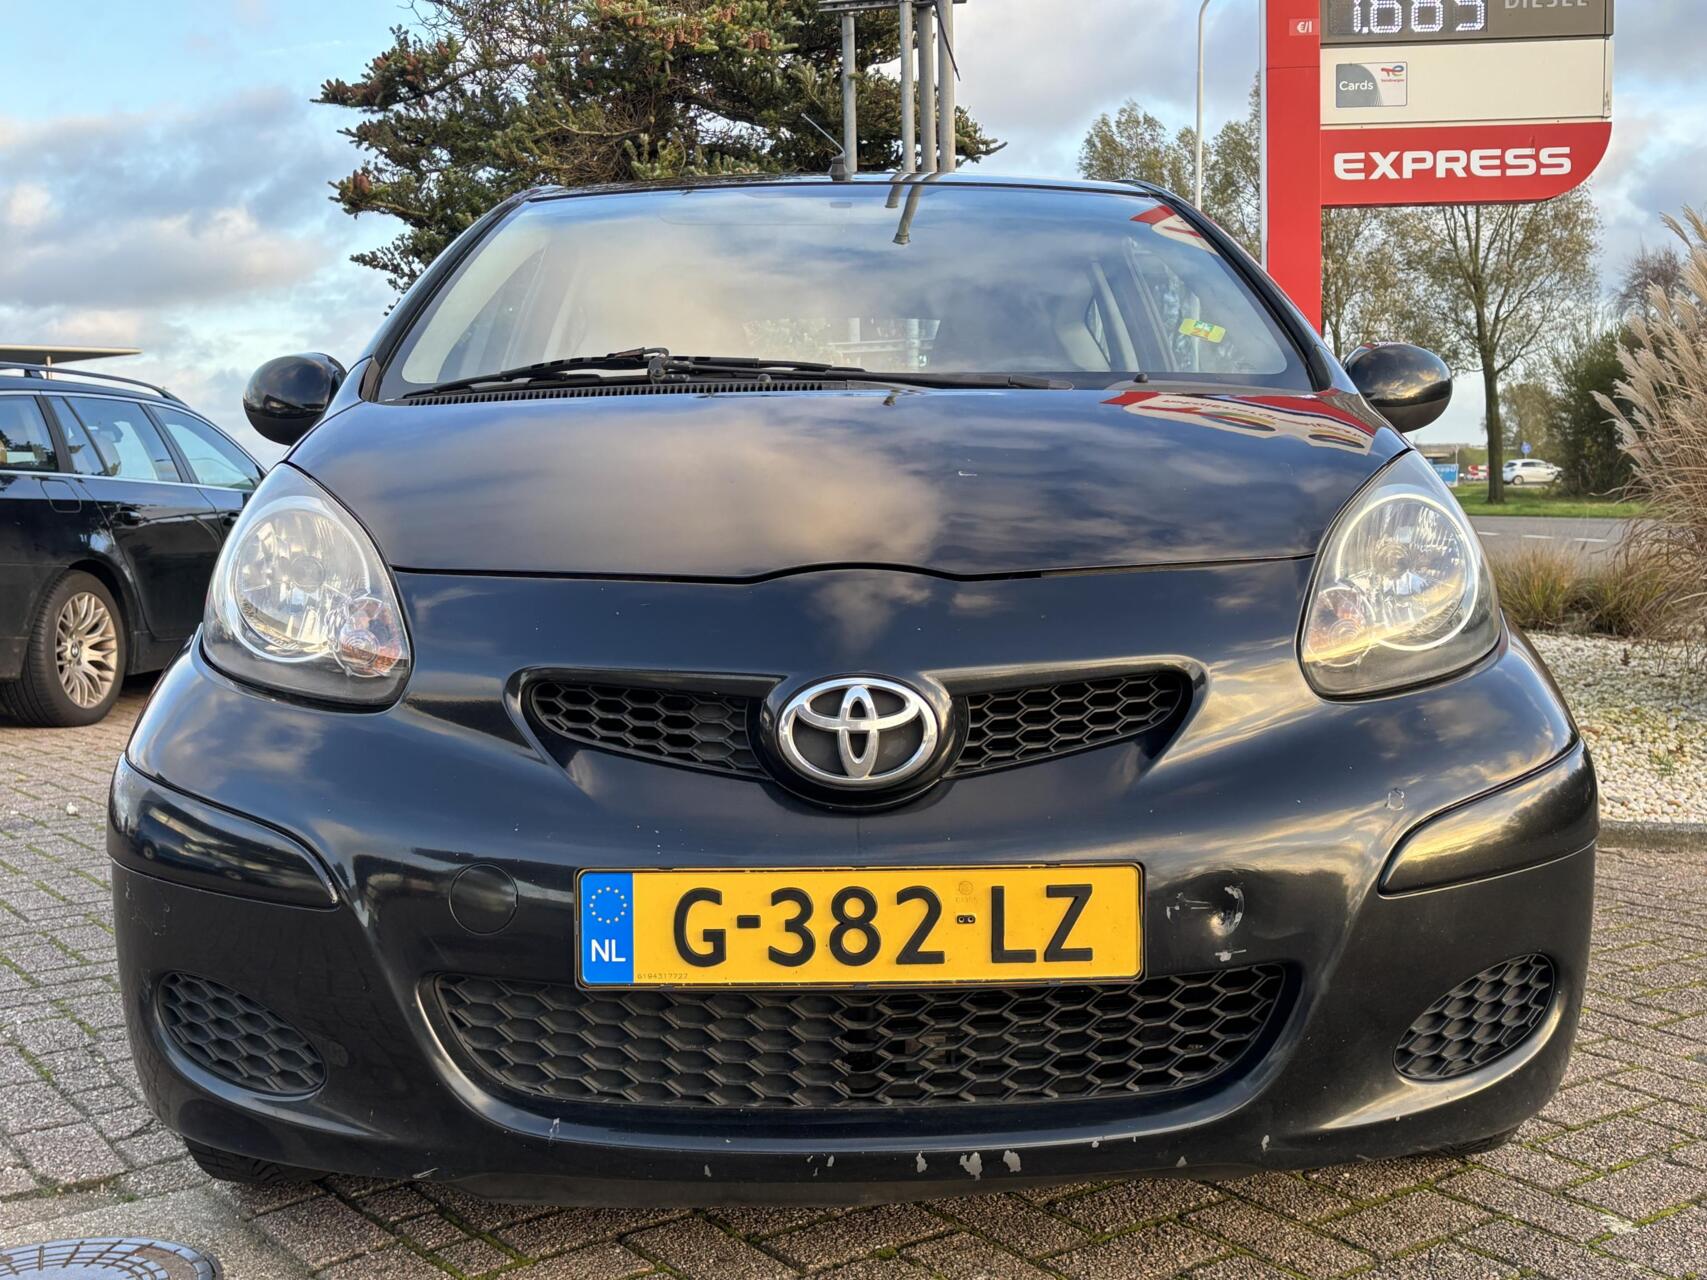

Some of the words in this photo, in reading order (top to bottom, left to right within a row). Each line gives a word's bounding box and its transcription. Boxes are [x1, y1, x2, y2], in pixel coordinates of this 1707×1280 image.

[1339, 80, 1374, 91] Cards
[1333, 147, 1572, 180] EXPRESS
[673, 884, 1093, 967] G-382-LZ
[591, 939, 626, 962] NL
